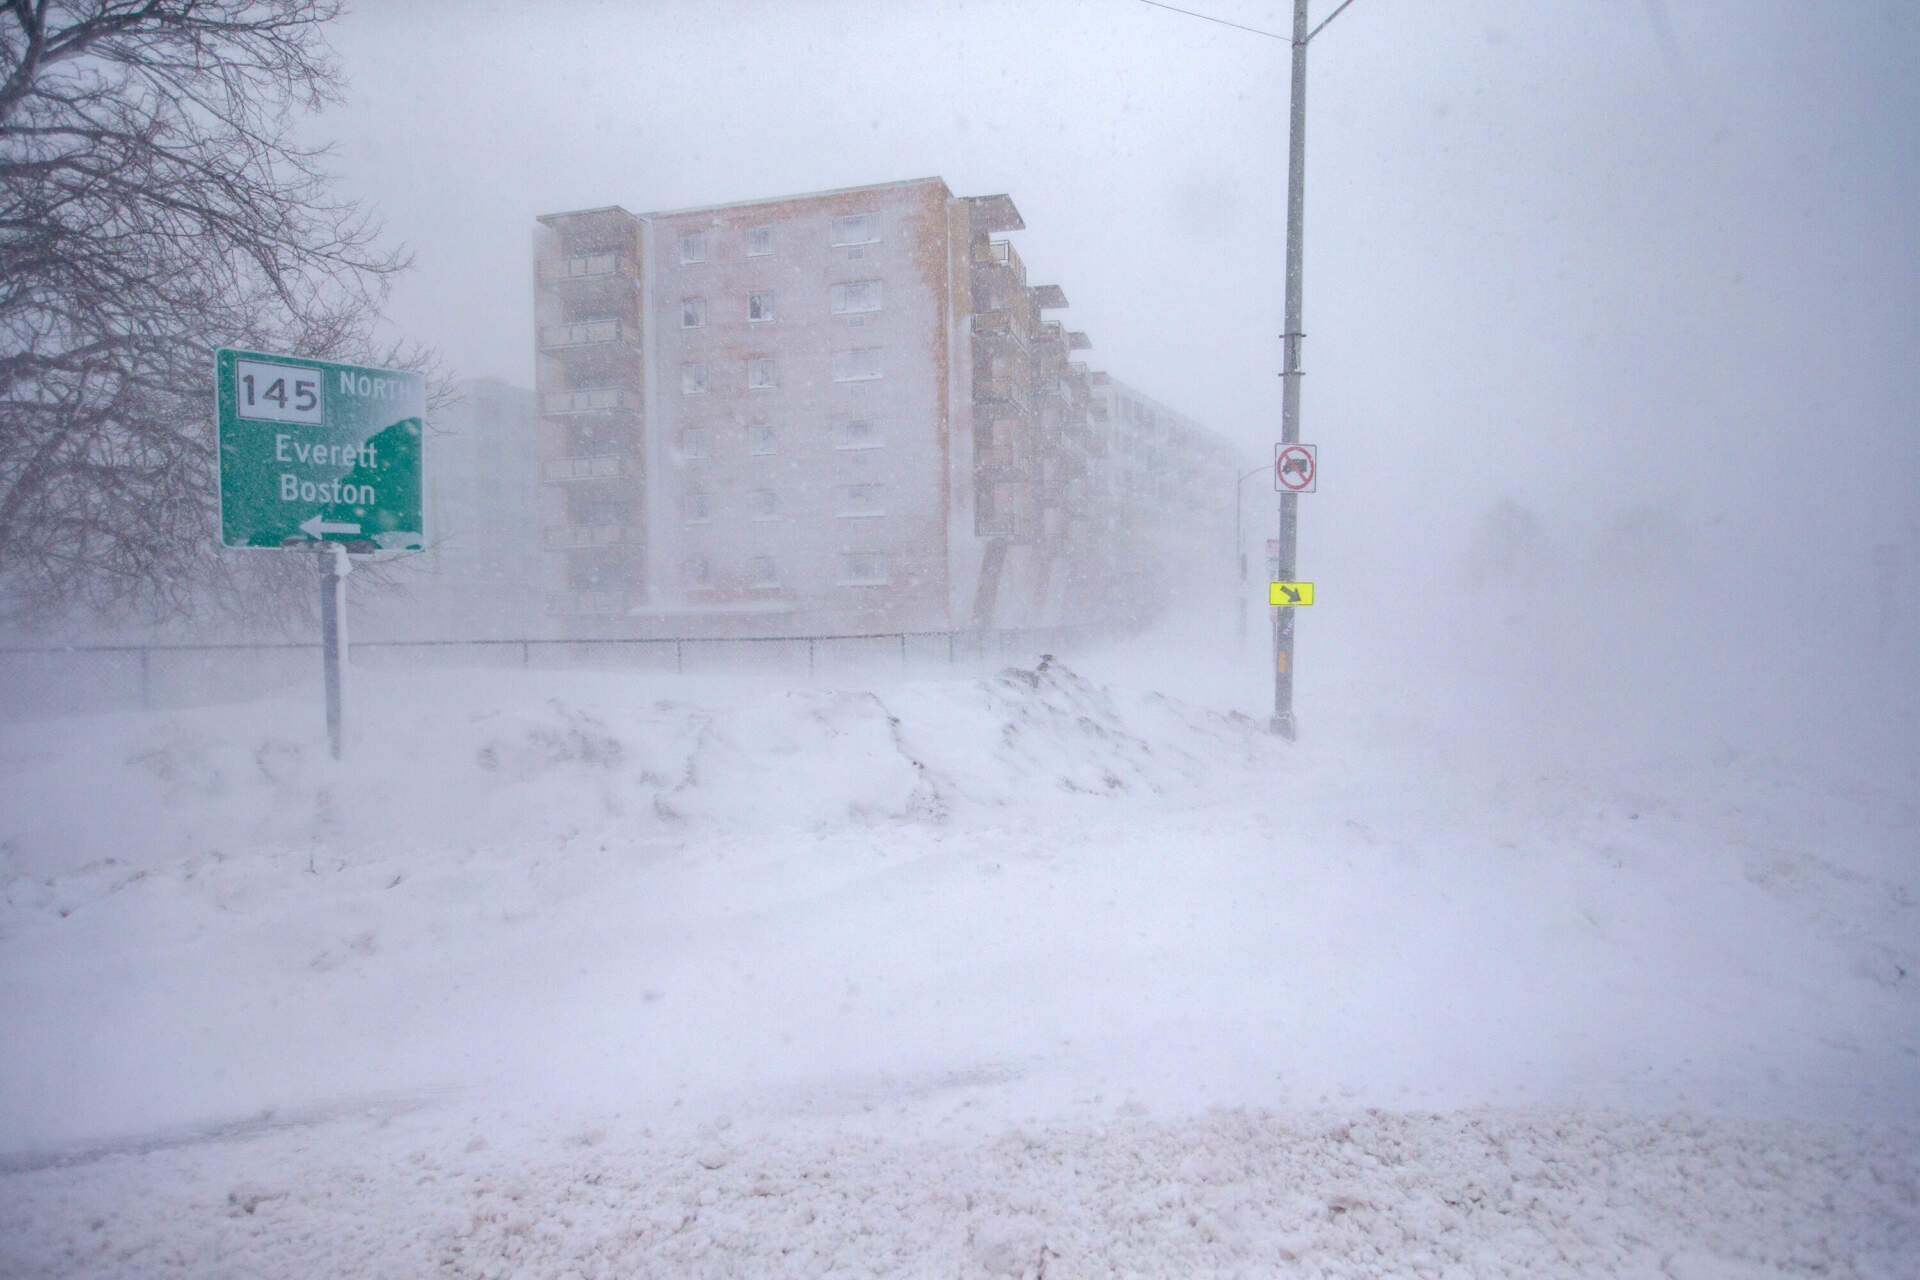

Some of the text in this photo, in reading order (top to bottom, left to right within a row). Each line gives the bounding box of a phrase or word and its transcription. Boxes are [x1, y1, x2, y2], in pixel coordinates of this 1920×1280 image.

[242, 374, 318, 412] 145
[275, 434, 378, 469] Everett
[280, 473, 375, 505] Boston
